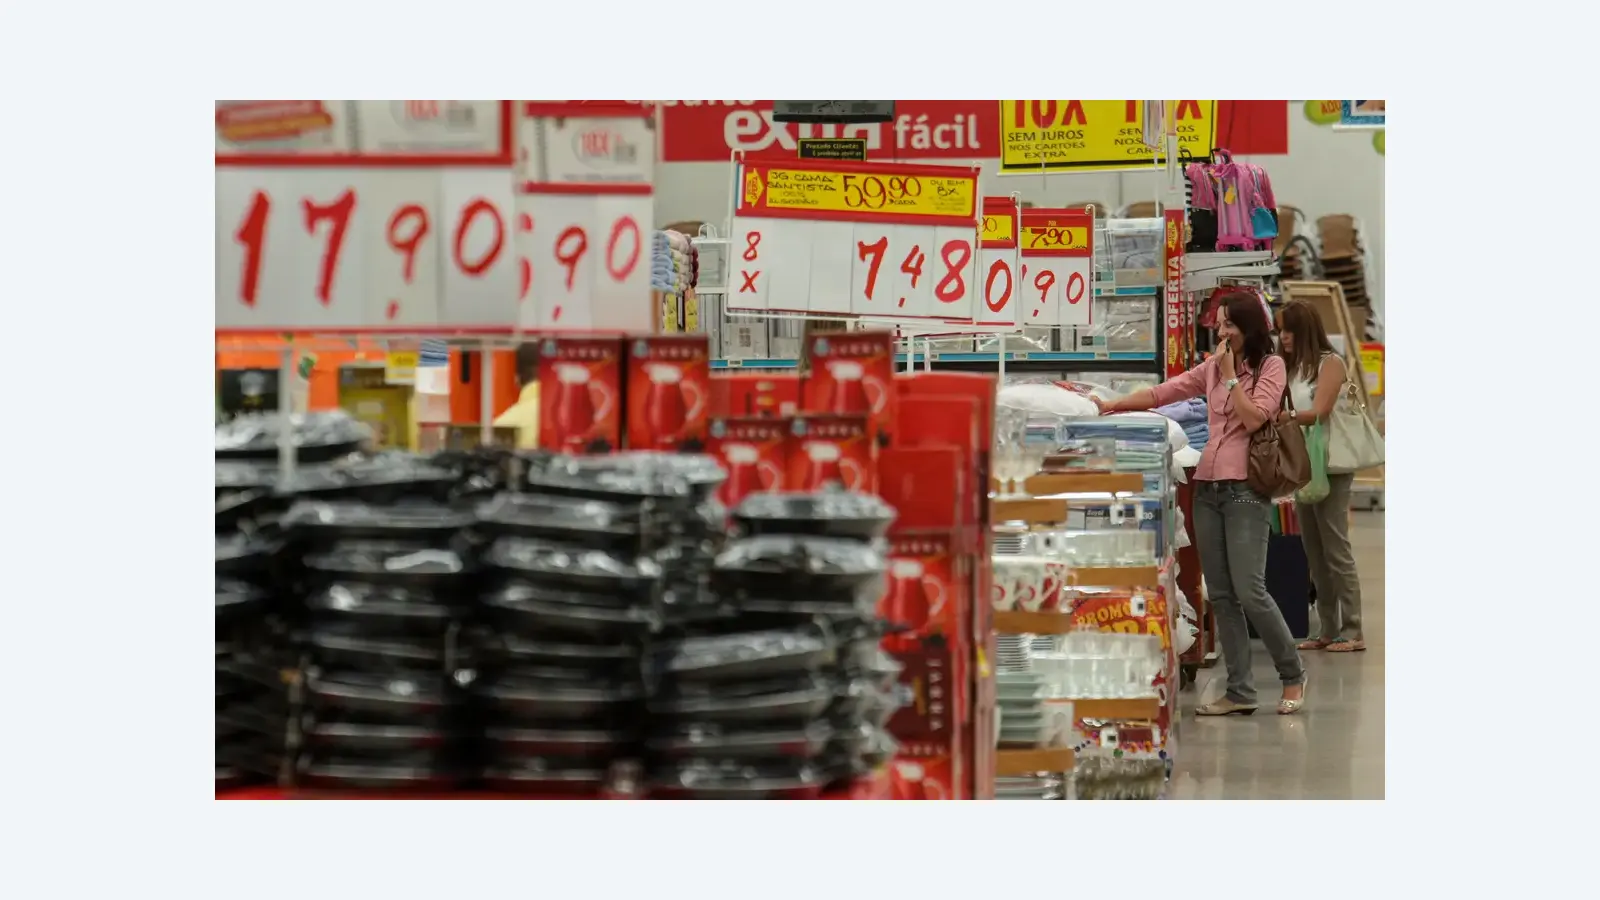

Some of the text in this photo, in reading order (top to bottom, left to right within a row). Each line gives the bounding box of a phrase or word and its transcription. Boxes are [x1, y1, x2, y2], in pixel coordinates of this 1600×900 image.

[894, 114, 981, 150] fácil
[1008, 129, 1084, 142] SEM JUROS
[1114, 138, 1143, 146] NOS
[1024, 150, 1067, 159] EXTRA
[767, 181, 837, 192] SANTISTA
[794, 174, 834, 182] CAMA
[744, 231, 761, 262] 8
[1030, 227, 1073, 249] 7,90
[234, 187, 506, 320] 17,90
[857, 235, 972, 308] 7,48
[1167, 255, 1180, 329] OFERTA
